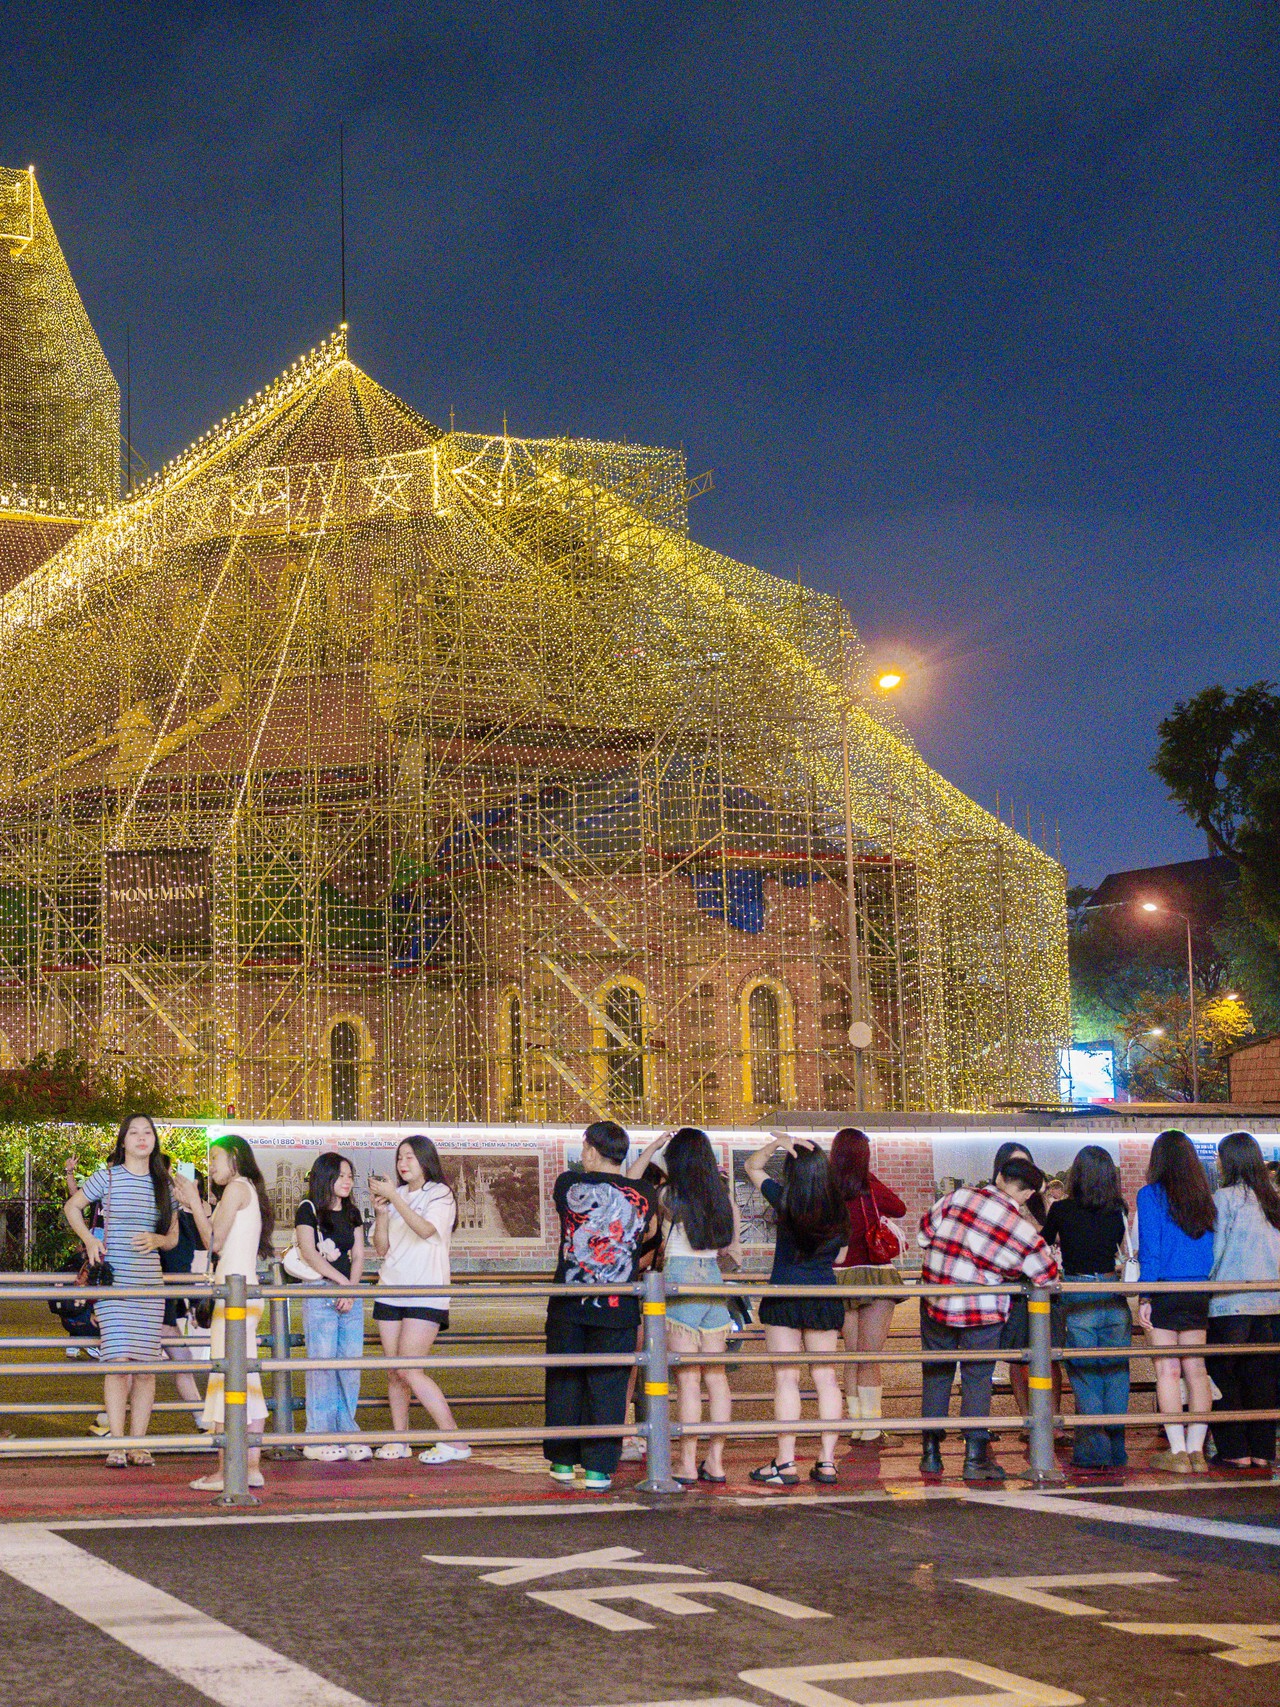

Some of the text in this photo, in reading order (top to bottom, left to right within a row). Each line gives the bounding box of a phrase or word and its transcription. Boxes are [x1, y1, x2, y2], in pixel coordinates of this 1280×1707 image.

[112, 885, 207, 903] MONUMENT
[131, 905, 157, 913] GROUP
[422, 1545, 834, 1632] XE
